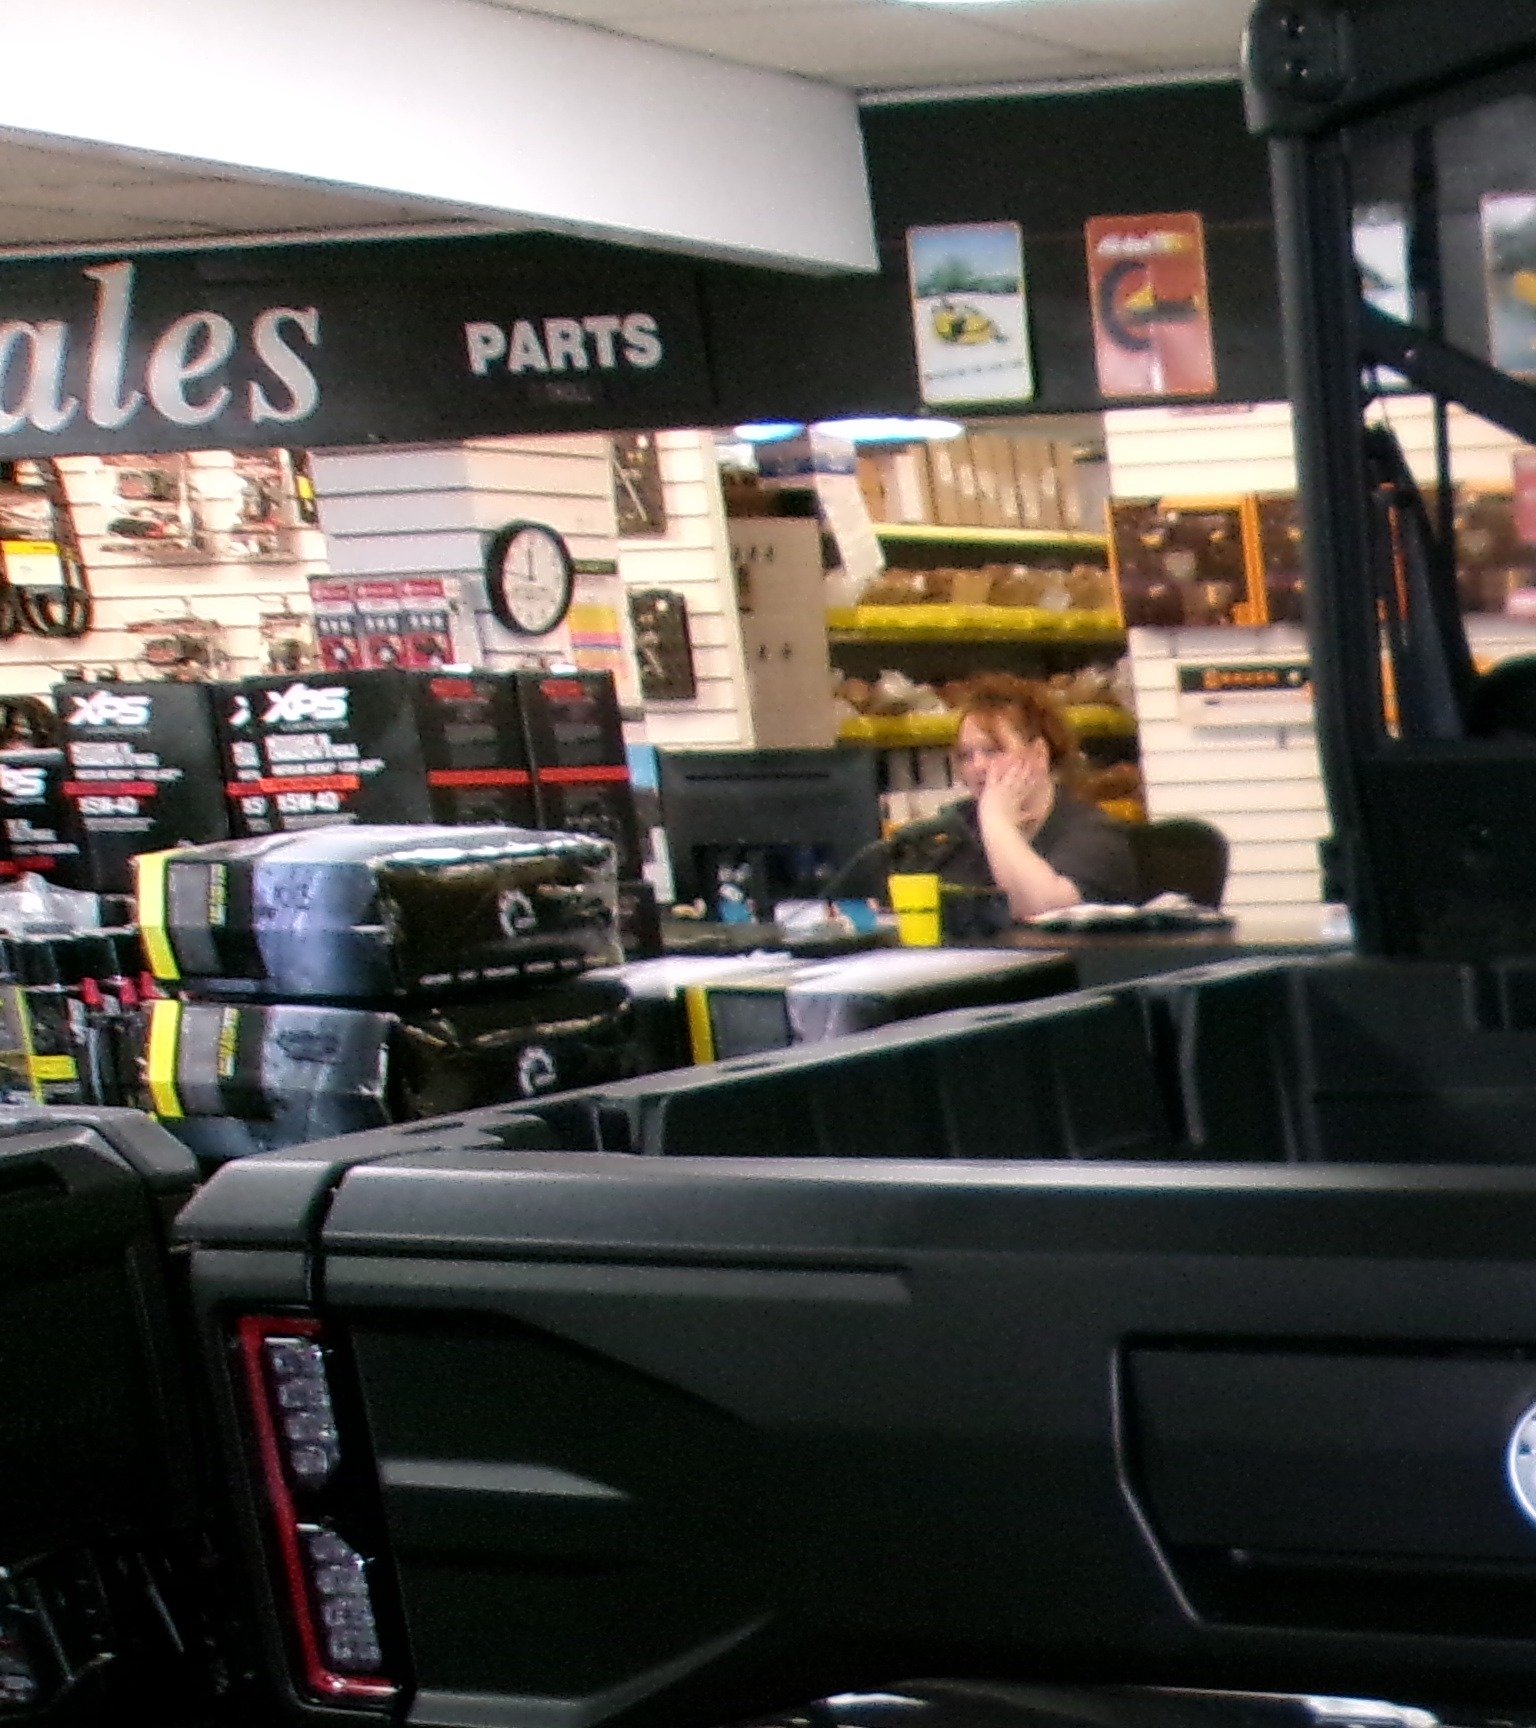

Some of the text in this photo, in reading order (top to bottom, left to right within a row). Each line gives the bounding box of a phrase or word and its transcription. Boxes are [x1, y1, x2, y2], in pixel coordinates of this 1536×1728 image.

[0, 261, 321, 434] ales
[464, 312, 663, 375] PARTS
[67, 690, 153, 725] XPS
[261, 682, 350, 722] XPS
